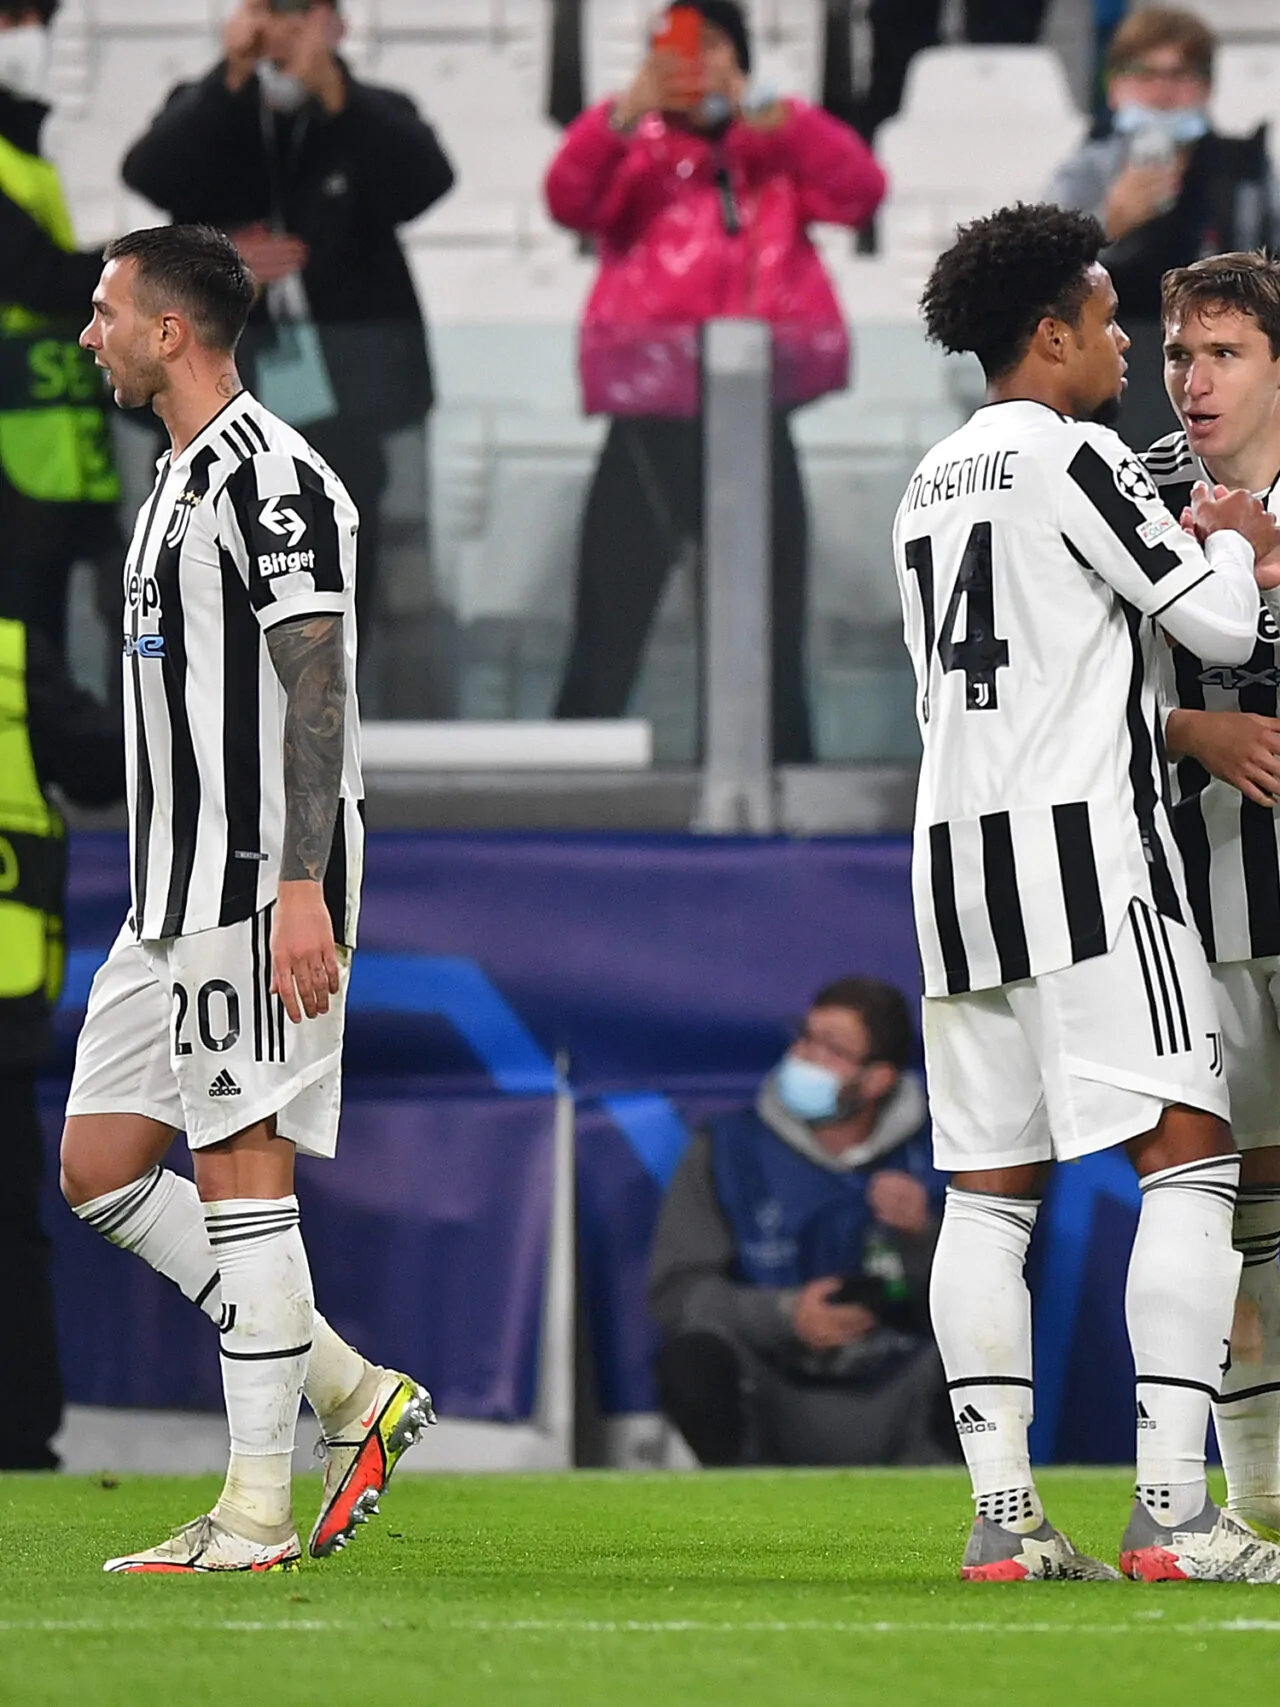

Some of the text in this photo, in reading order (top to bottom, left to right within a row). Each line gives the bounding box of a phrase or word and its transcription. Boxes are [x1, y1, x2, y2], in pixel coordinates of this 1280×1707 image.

[257, 549, 316, 578] Bitget
[904, 520, 1010, 724] 14
[171, 978, 241, 1055] 20
[208, 1087, 242, 1098] adidas
